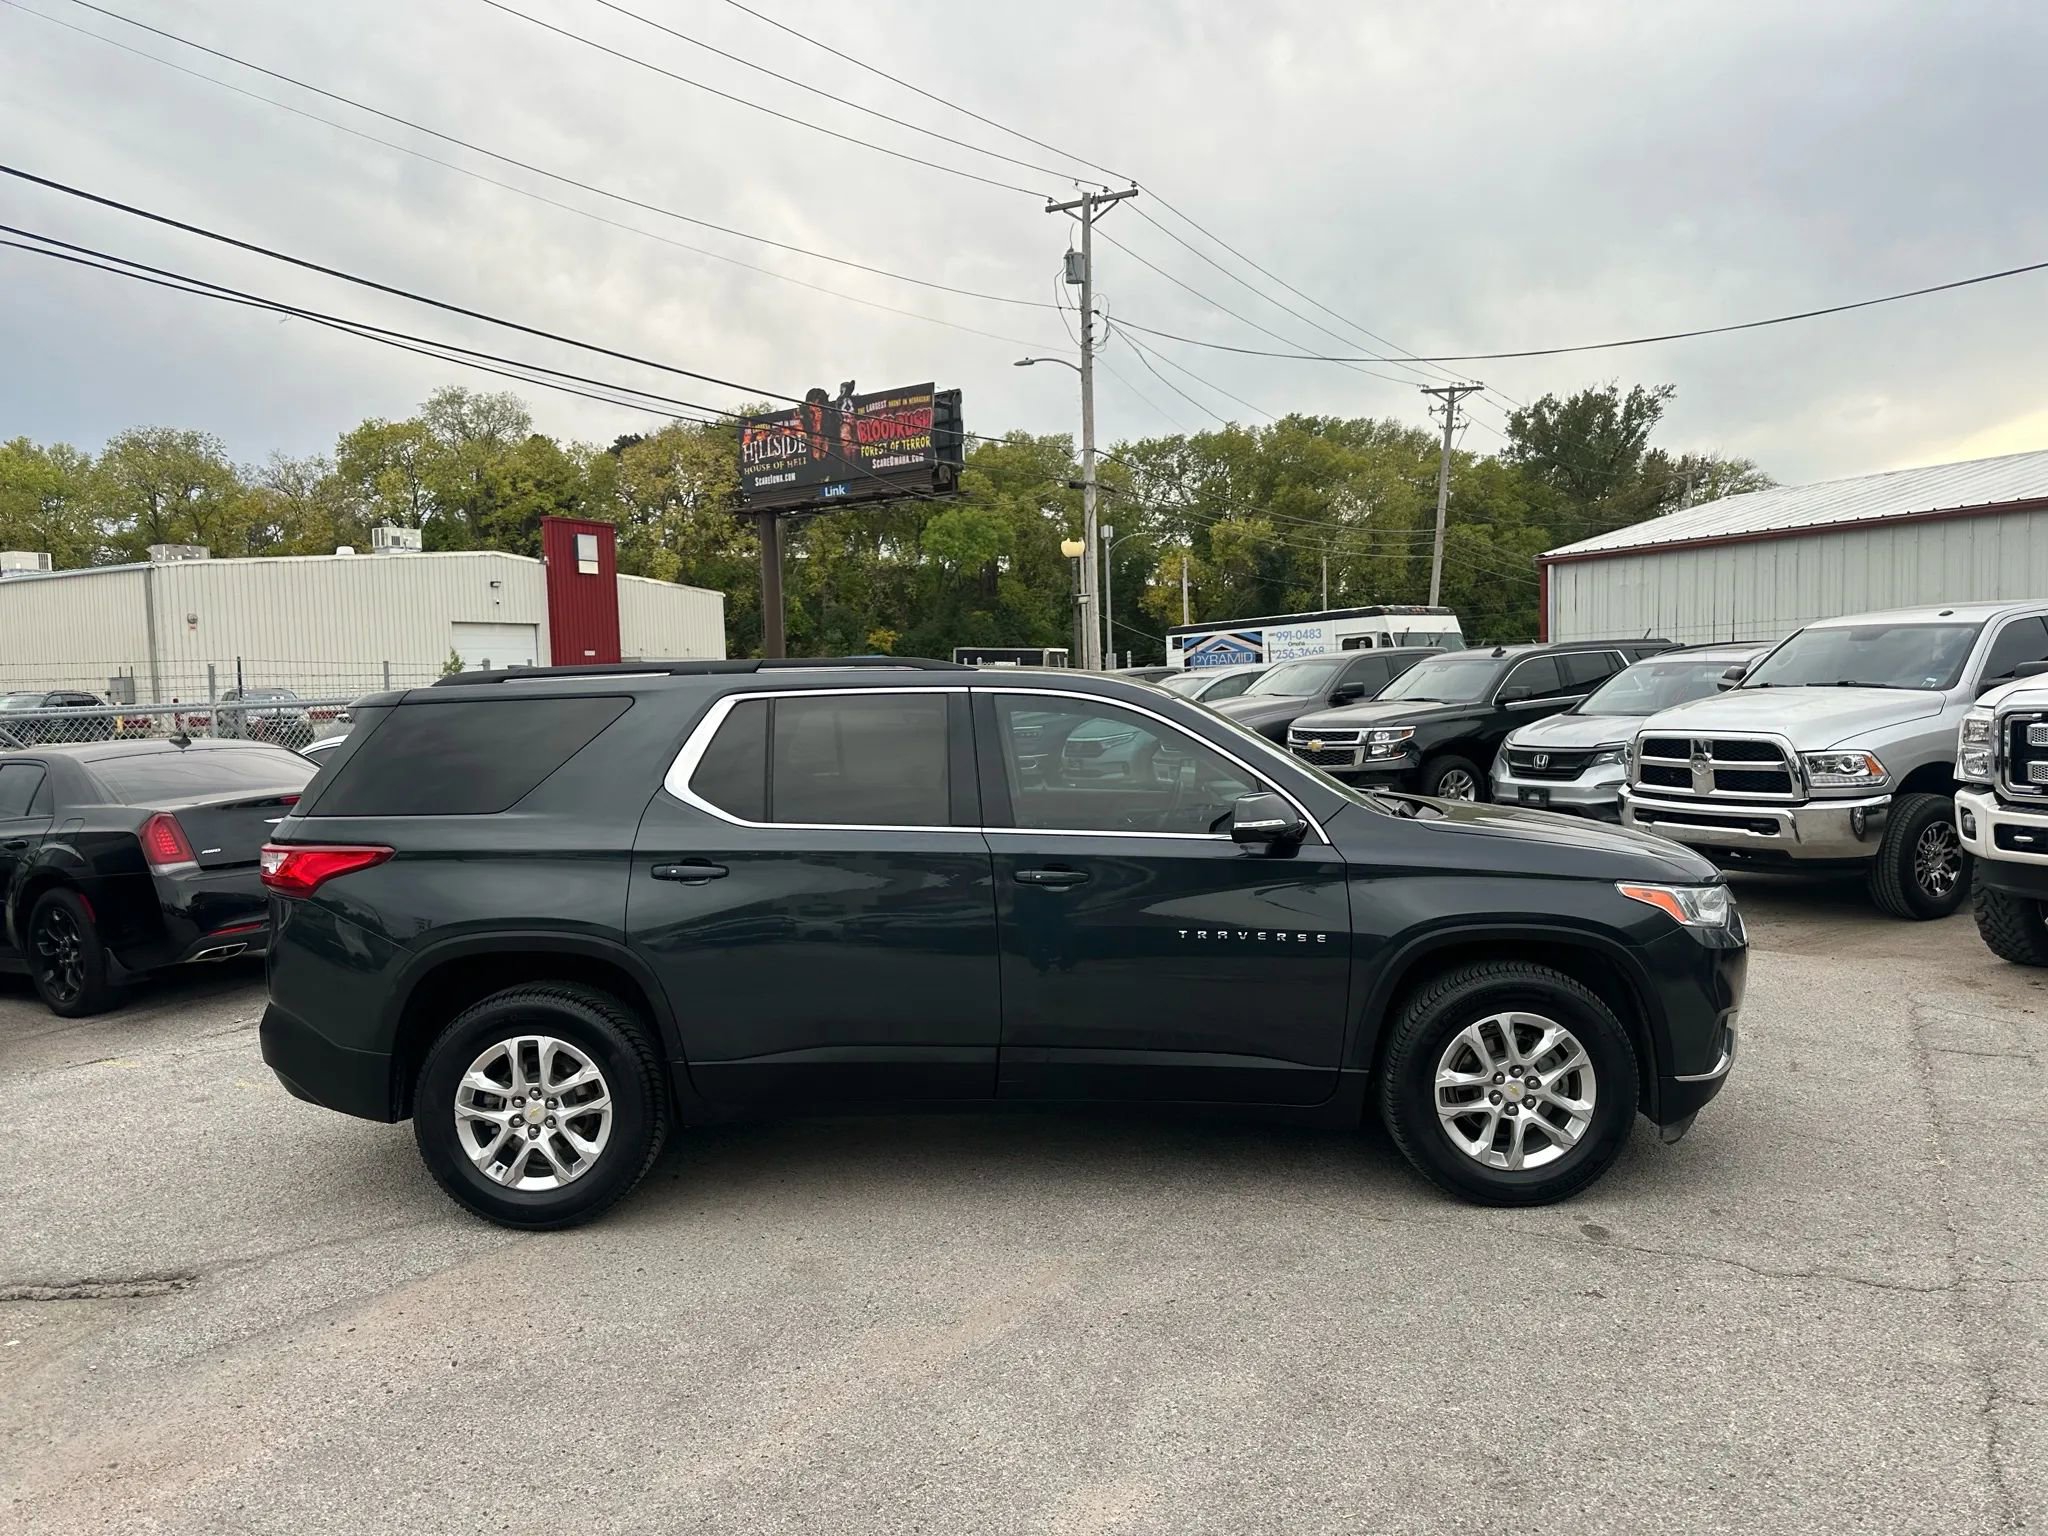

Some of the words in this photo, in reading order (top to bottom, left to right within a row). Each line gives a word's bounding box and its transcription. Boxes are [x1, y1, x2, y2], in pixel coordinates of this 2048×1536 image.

[866, 400, 887, 413] LARGEST
[742, 435, 807, 464] HILLSIDE
[861, 443, 888, 458] FOREST
[890, 440, 900, 451] OF
[901, 436, 932, 450] TERROR
[744, 463, 771, 475] HOUSE
[773, 461, 785, 471] OF
[786, 457, 807, 468] HELL
[825, 485, 846, 497] Link
[1276, 628, 1322, 641] 991-0483
[1193, 651, 1253, 667] PYRAMID
[1178, 930, 1327, 943] TRAVERSE
